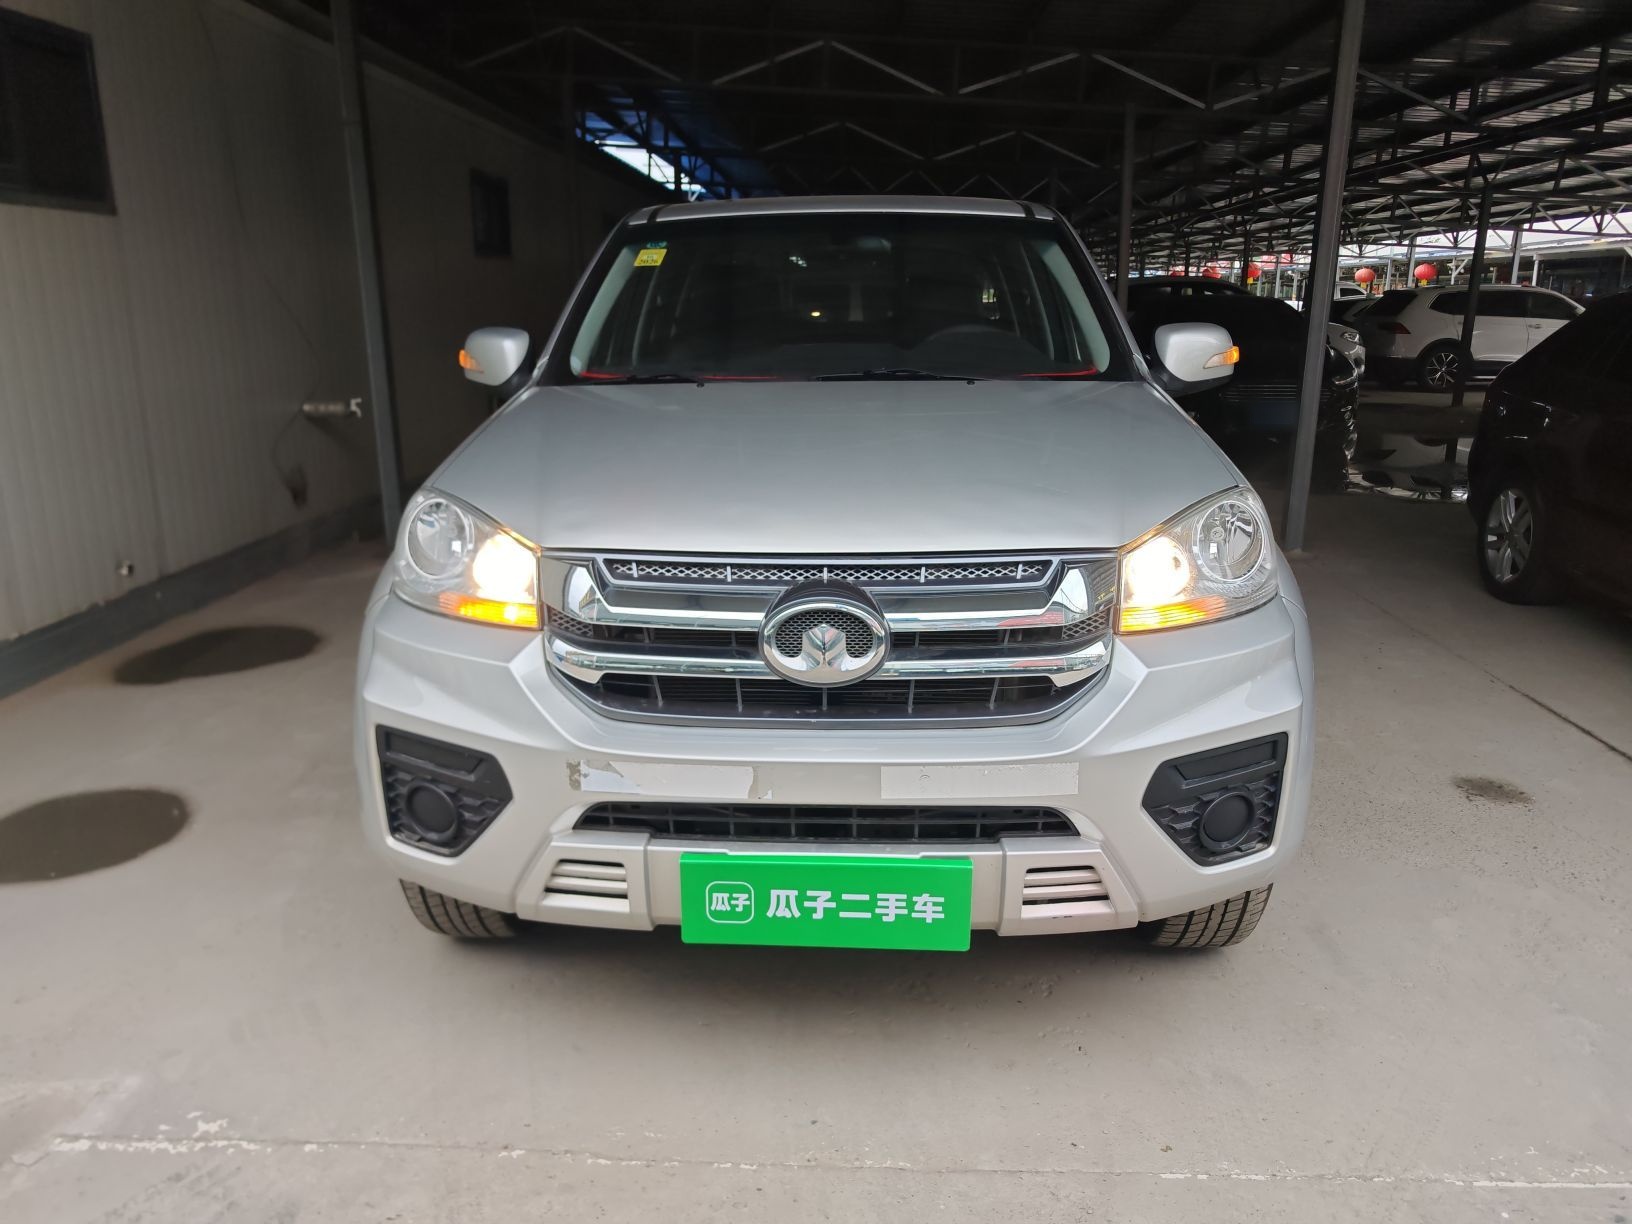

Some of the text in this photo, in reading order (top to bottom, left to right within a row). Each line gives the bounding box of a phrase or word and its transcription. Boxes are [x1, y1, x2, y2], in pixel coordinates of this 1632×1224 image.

[710, 892, 750, 912] 瓜子
[766, 889, 945, 923] 瓜子二手车
